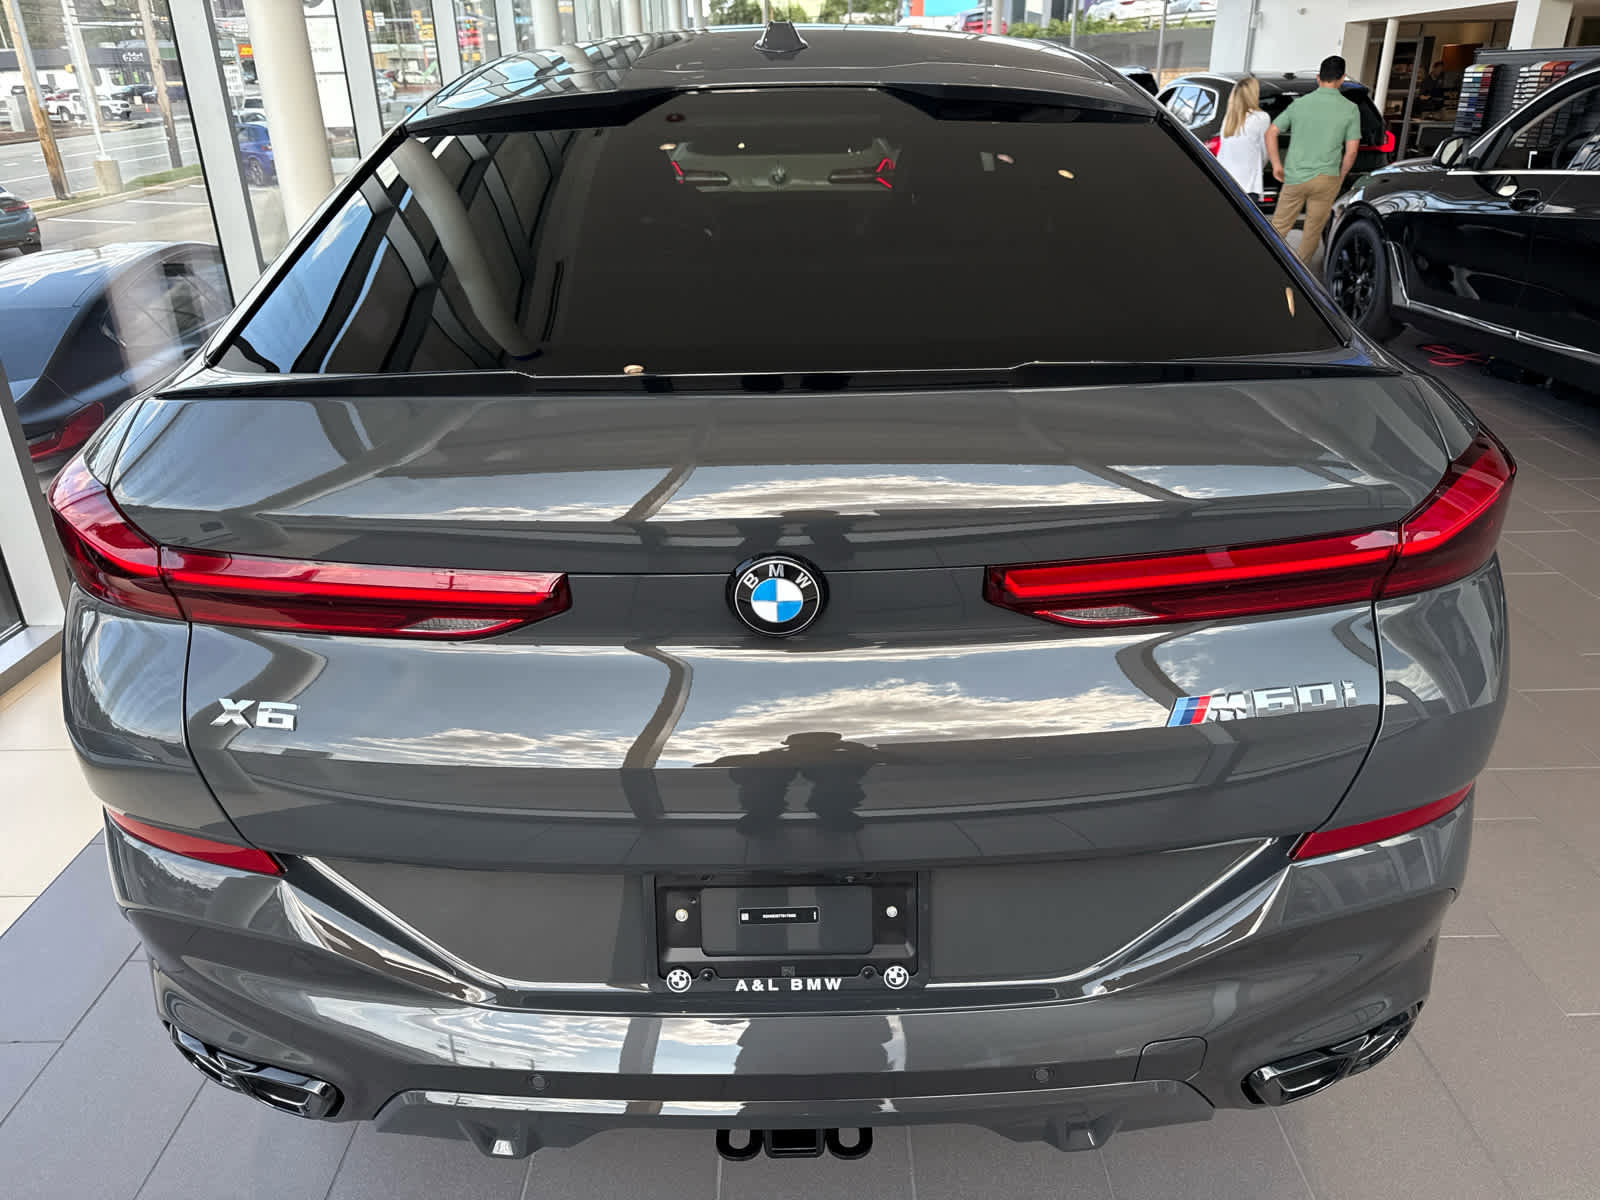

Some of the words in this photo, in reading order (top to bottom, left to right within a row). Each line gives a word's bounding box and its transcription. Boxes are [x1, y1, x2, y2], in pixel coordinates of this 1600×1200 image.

[743, 564, 812, 590] BMW
[210, 698, 297, 731] X6
[1203, 680, 1357, 724] M60i
[735, 979, 779, 992] A&L
[790, 978, 842, 991] BMW
